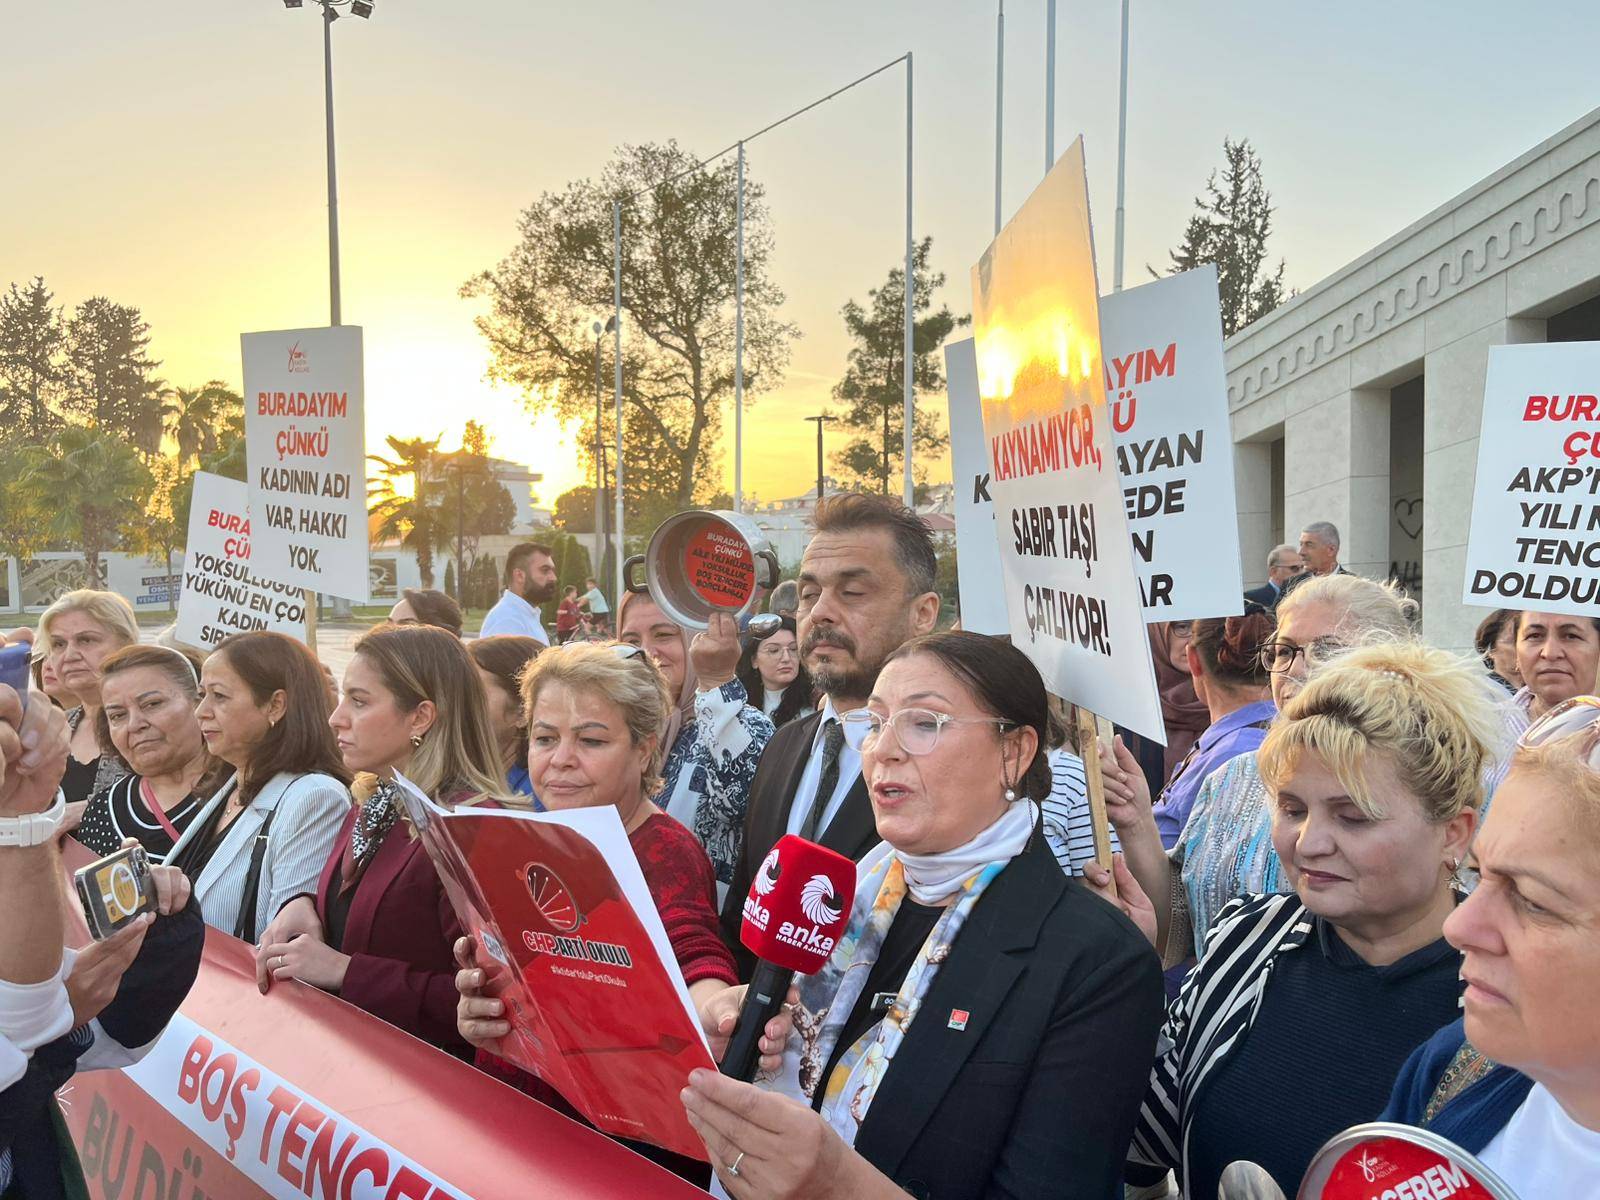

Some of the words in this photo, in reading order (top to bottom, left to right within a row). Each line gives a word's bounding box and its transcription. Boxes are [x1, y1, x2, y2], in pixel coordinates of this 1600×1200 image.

[258, 392, 348, 418] BURADAYIM
[276, 426, 329, 461] ÇÜNKÜ
[991, 403, 1103, 482] KAYNAMIYOR,
[260, 467, 318, 496] KADININ
[321, 472, 350, 499] ADI
[266, 504, 297, 535] VAR,
[299, 509, 348, 539] HAKKI
[1519, 502, 1583, 530] YILI
[1011, 506, 1057, 557] SABIR
[1057, 503, 1098, 579] TAŞI
[287, 544, 322, 574] YOK.
[185, 571, 249, 606] YÜKÜNÜ
[250, 593, 273, 614] EN
[217, 606, 269, 631] KADIN
[1023, 583, 1112, 657] ÇATLIYOR!
[744, 896, 770, 926] anka
[775, 933, 803, 948] HABER
[802, 944, 829, 957] AJANSI
[778, 921, 834, 951] anka
[586, 939, 633, 968] OKULU
[176, 1034, 261, 1162] BOŞ
[82, 1089, 136, 1200] BU
